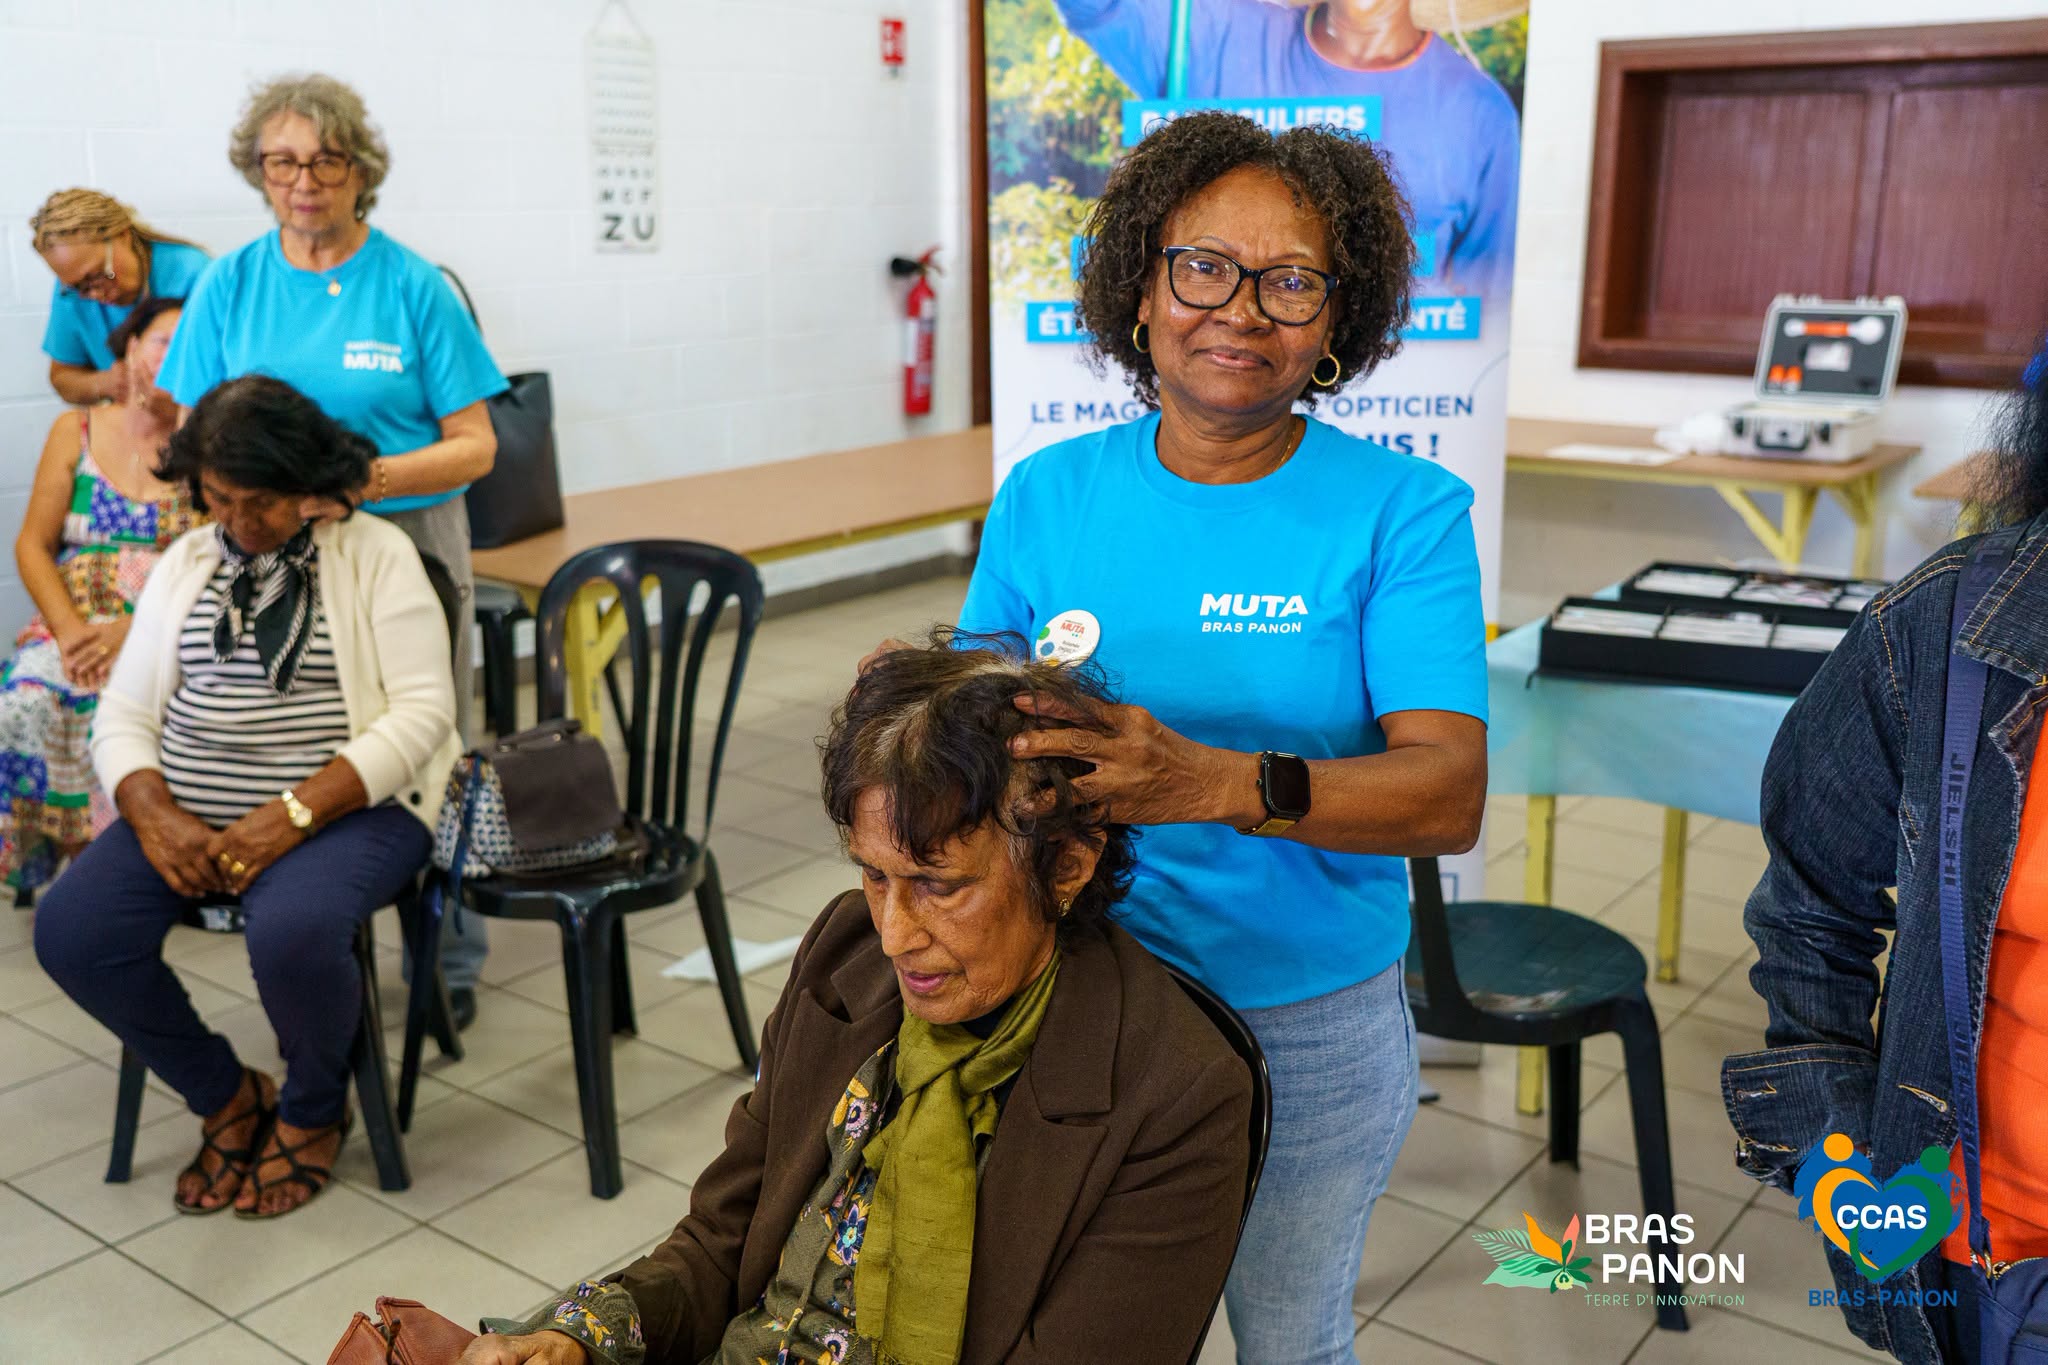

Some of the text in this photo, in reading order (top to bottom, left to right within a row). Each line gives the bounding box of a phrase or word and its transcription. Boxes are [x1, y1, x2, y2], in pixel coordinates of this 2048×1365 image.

[1031, 401, 1063, 423] LE
[1200, 593, 1308, 618] MUTA
[1202, 621, 1301, 634] BRAS PANON
